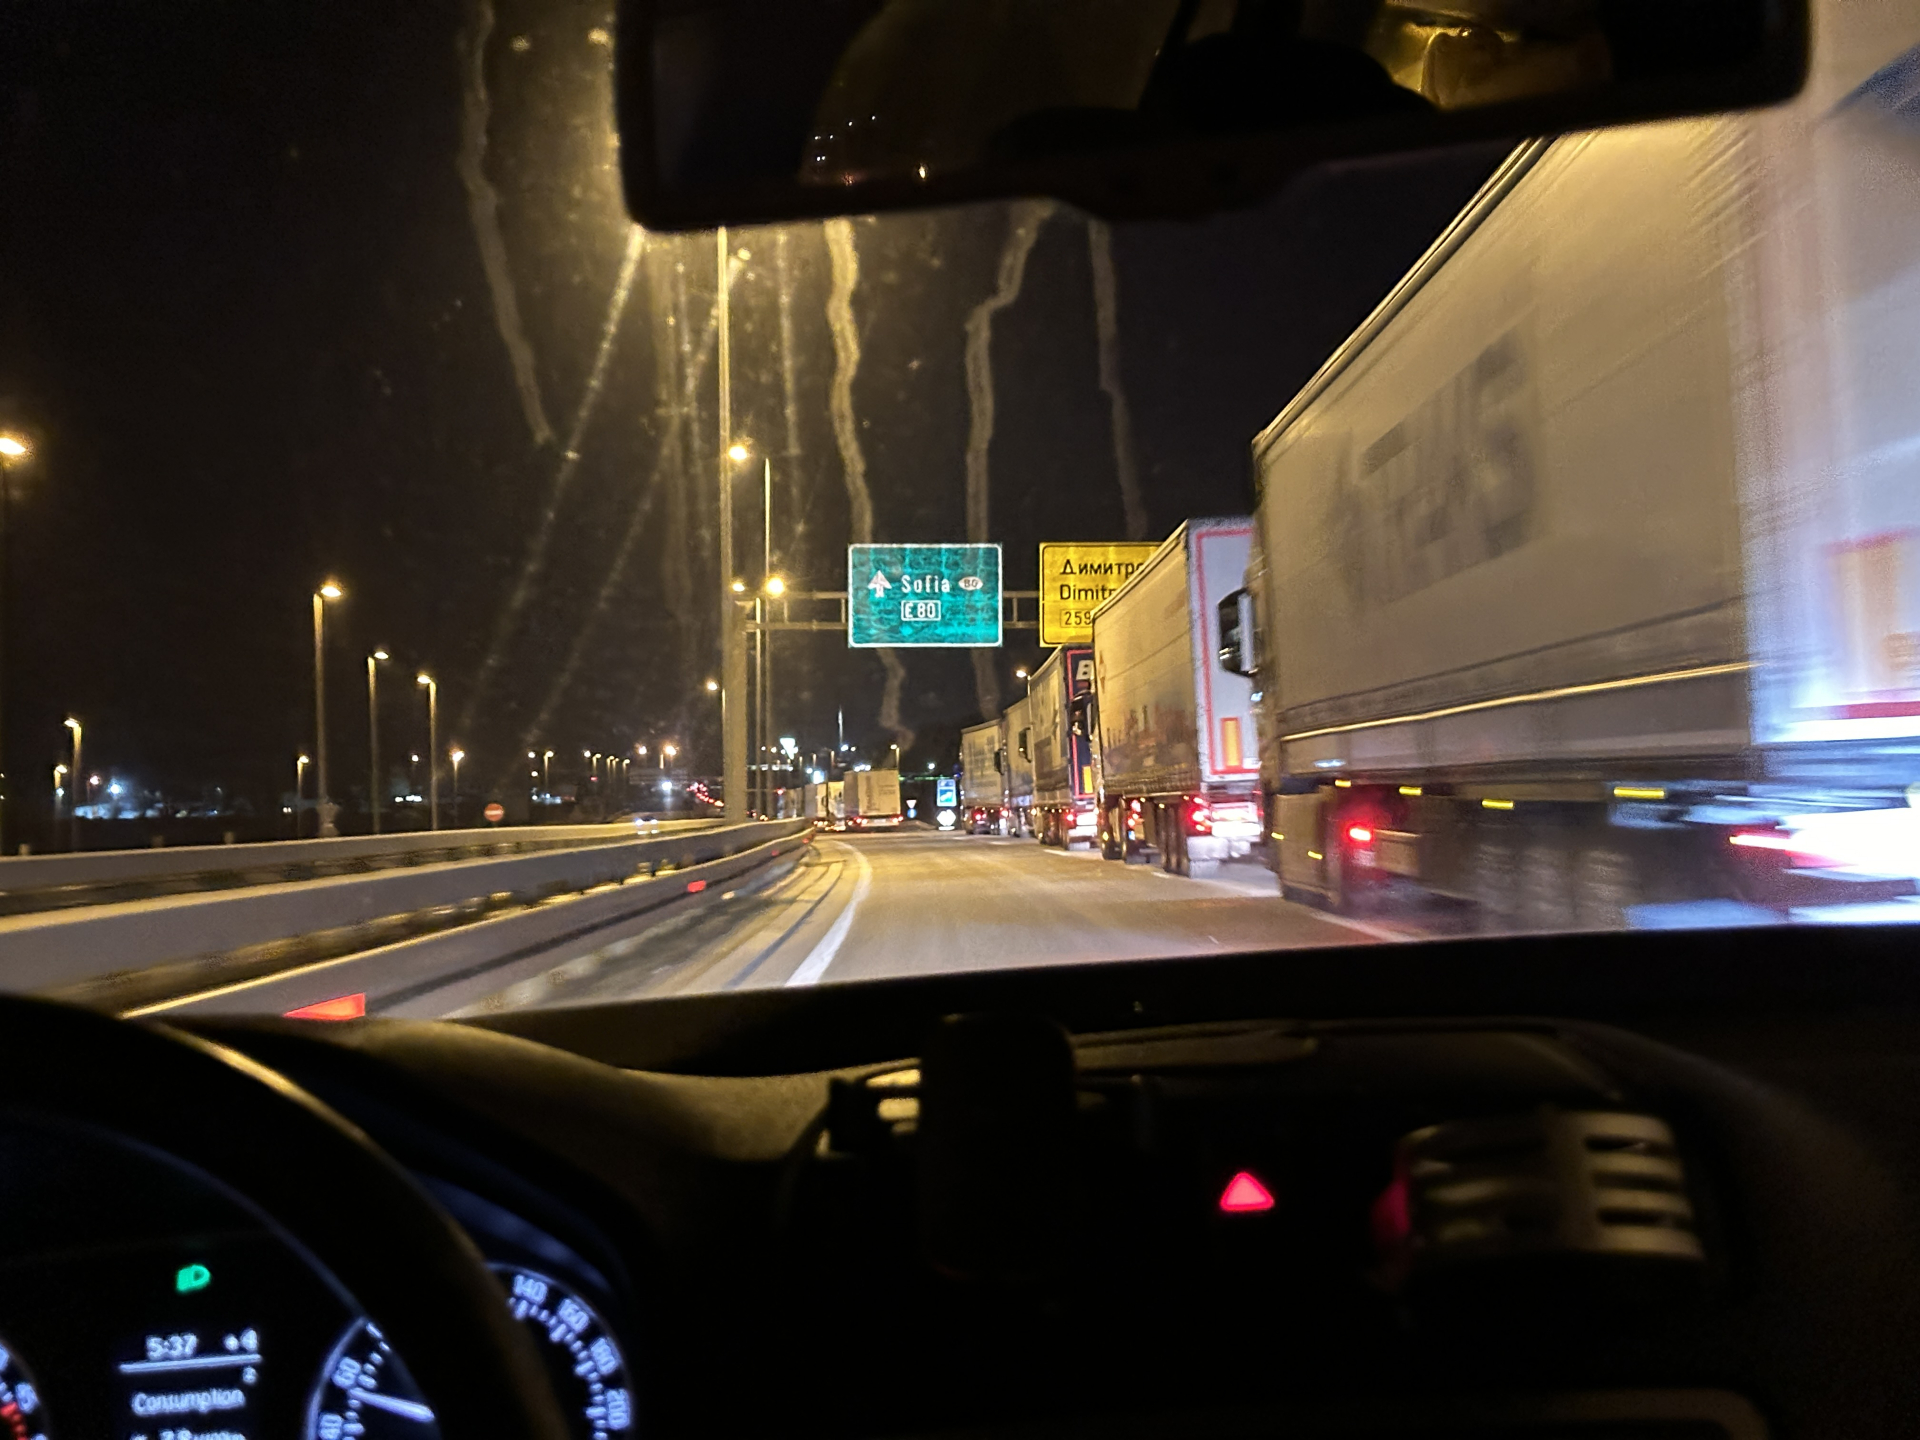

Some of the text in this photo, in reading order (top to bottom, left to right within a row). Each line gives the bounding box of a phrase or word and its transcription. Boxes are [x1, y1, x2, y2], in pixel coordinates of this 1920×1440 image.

[901, 575, 951, 593] Sofia
[904, 602, 936, 618] E 80
[131, 1388, 246, 1417] Consumption
